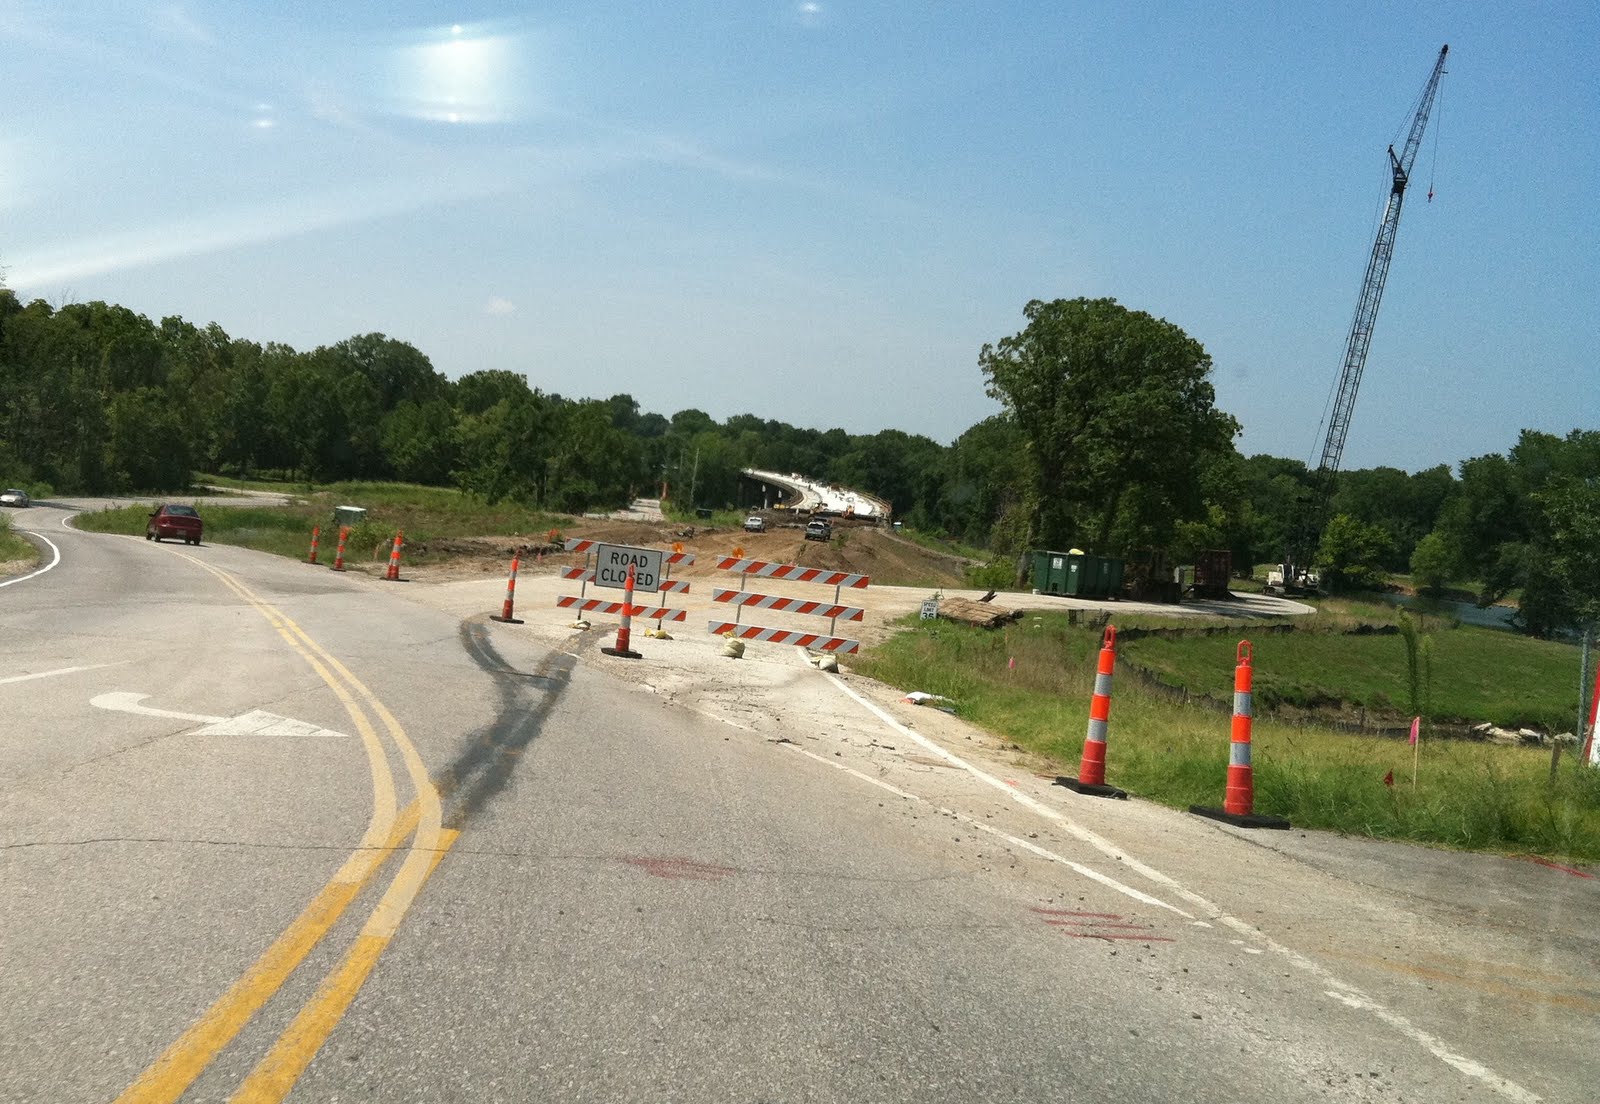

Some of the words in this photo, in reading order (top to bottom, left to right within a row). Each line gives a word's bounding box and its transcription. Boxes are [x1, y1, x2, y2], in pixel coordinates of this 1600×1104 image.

[611, 552, 648, 568] ROAD
[601, 568, 653, 586] CLOED
[922, 612, 934, 620] 35
